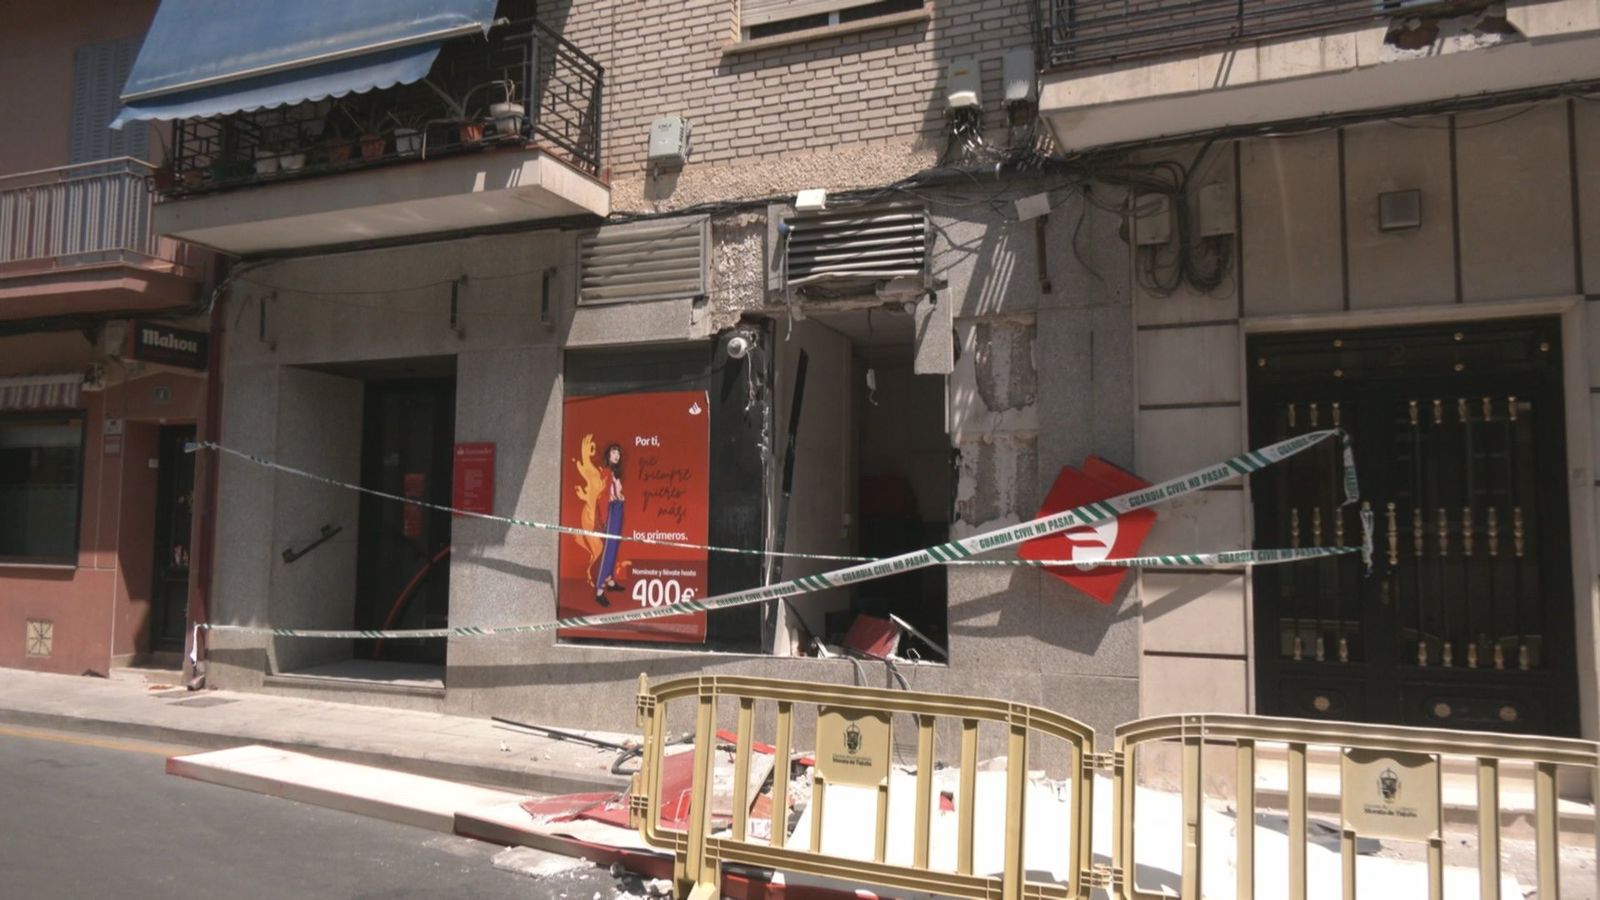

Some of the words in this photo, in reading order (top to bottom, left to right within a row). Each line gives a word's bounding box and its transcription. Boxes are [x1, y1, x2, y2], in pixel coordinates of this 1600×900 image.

[142, 328, 198, 353] Mahou
[635, 435, 650, 447] Por
[651, 434, 661, 447] ti,
[1128, 489, 1166, 508] GUARDIA
[1166, 480, 1188, 497] CIVIL
[1187, 475, 1201, 490] NO
[1201, 466, 1230, 485] PASAR
[633, 530, 645, 540] los
[646, 530, 688, 541] primeros.
[979, 531, 1013, 550] GUARDIA
[1013, 525, 1034, 541] CIVIL
[1034, 522, 1047, 534] NO
[1048, 514, 1075, 531] PASAR
[1217, 551, 1254, 563] GUARDIA
[841, 567, 873, 582] GUARDIA
[873, 562, 893, 577] CIVIL
[893, 559, 905, 571] NO
[904, 553, 930, 568] PASAR
[773, 584, 797, 597] PASAR
